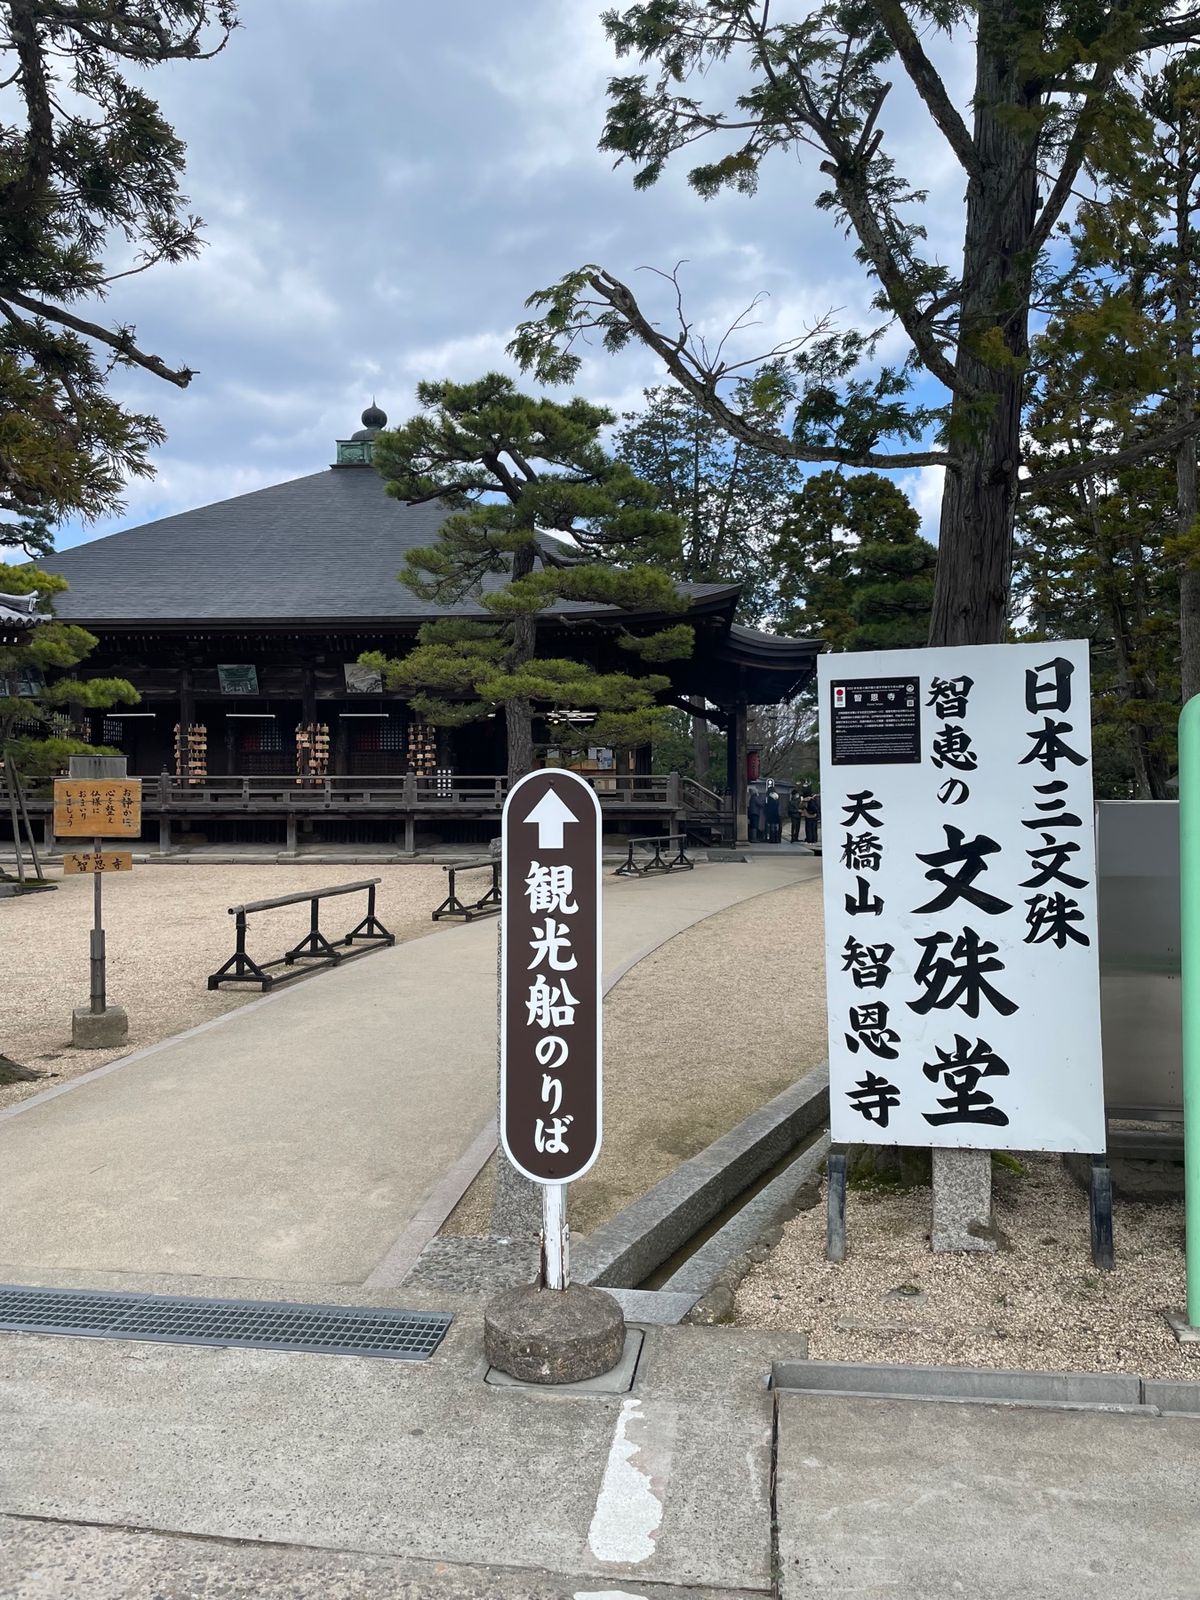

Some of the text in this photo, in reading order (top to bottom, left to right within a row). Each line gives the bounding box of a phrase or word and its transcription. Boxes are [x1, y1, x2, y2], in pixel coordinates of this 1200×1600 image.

[66, 790, 74, 827] しましょう
[90, 790, 102, 814] 仏様に
[1018, 656, 1091, 949] 日本三文殊
[77, 858, 123, 872] 智恩寺
[524, 860, 580, 1155] 観光船のりば
